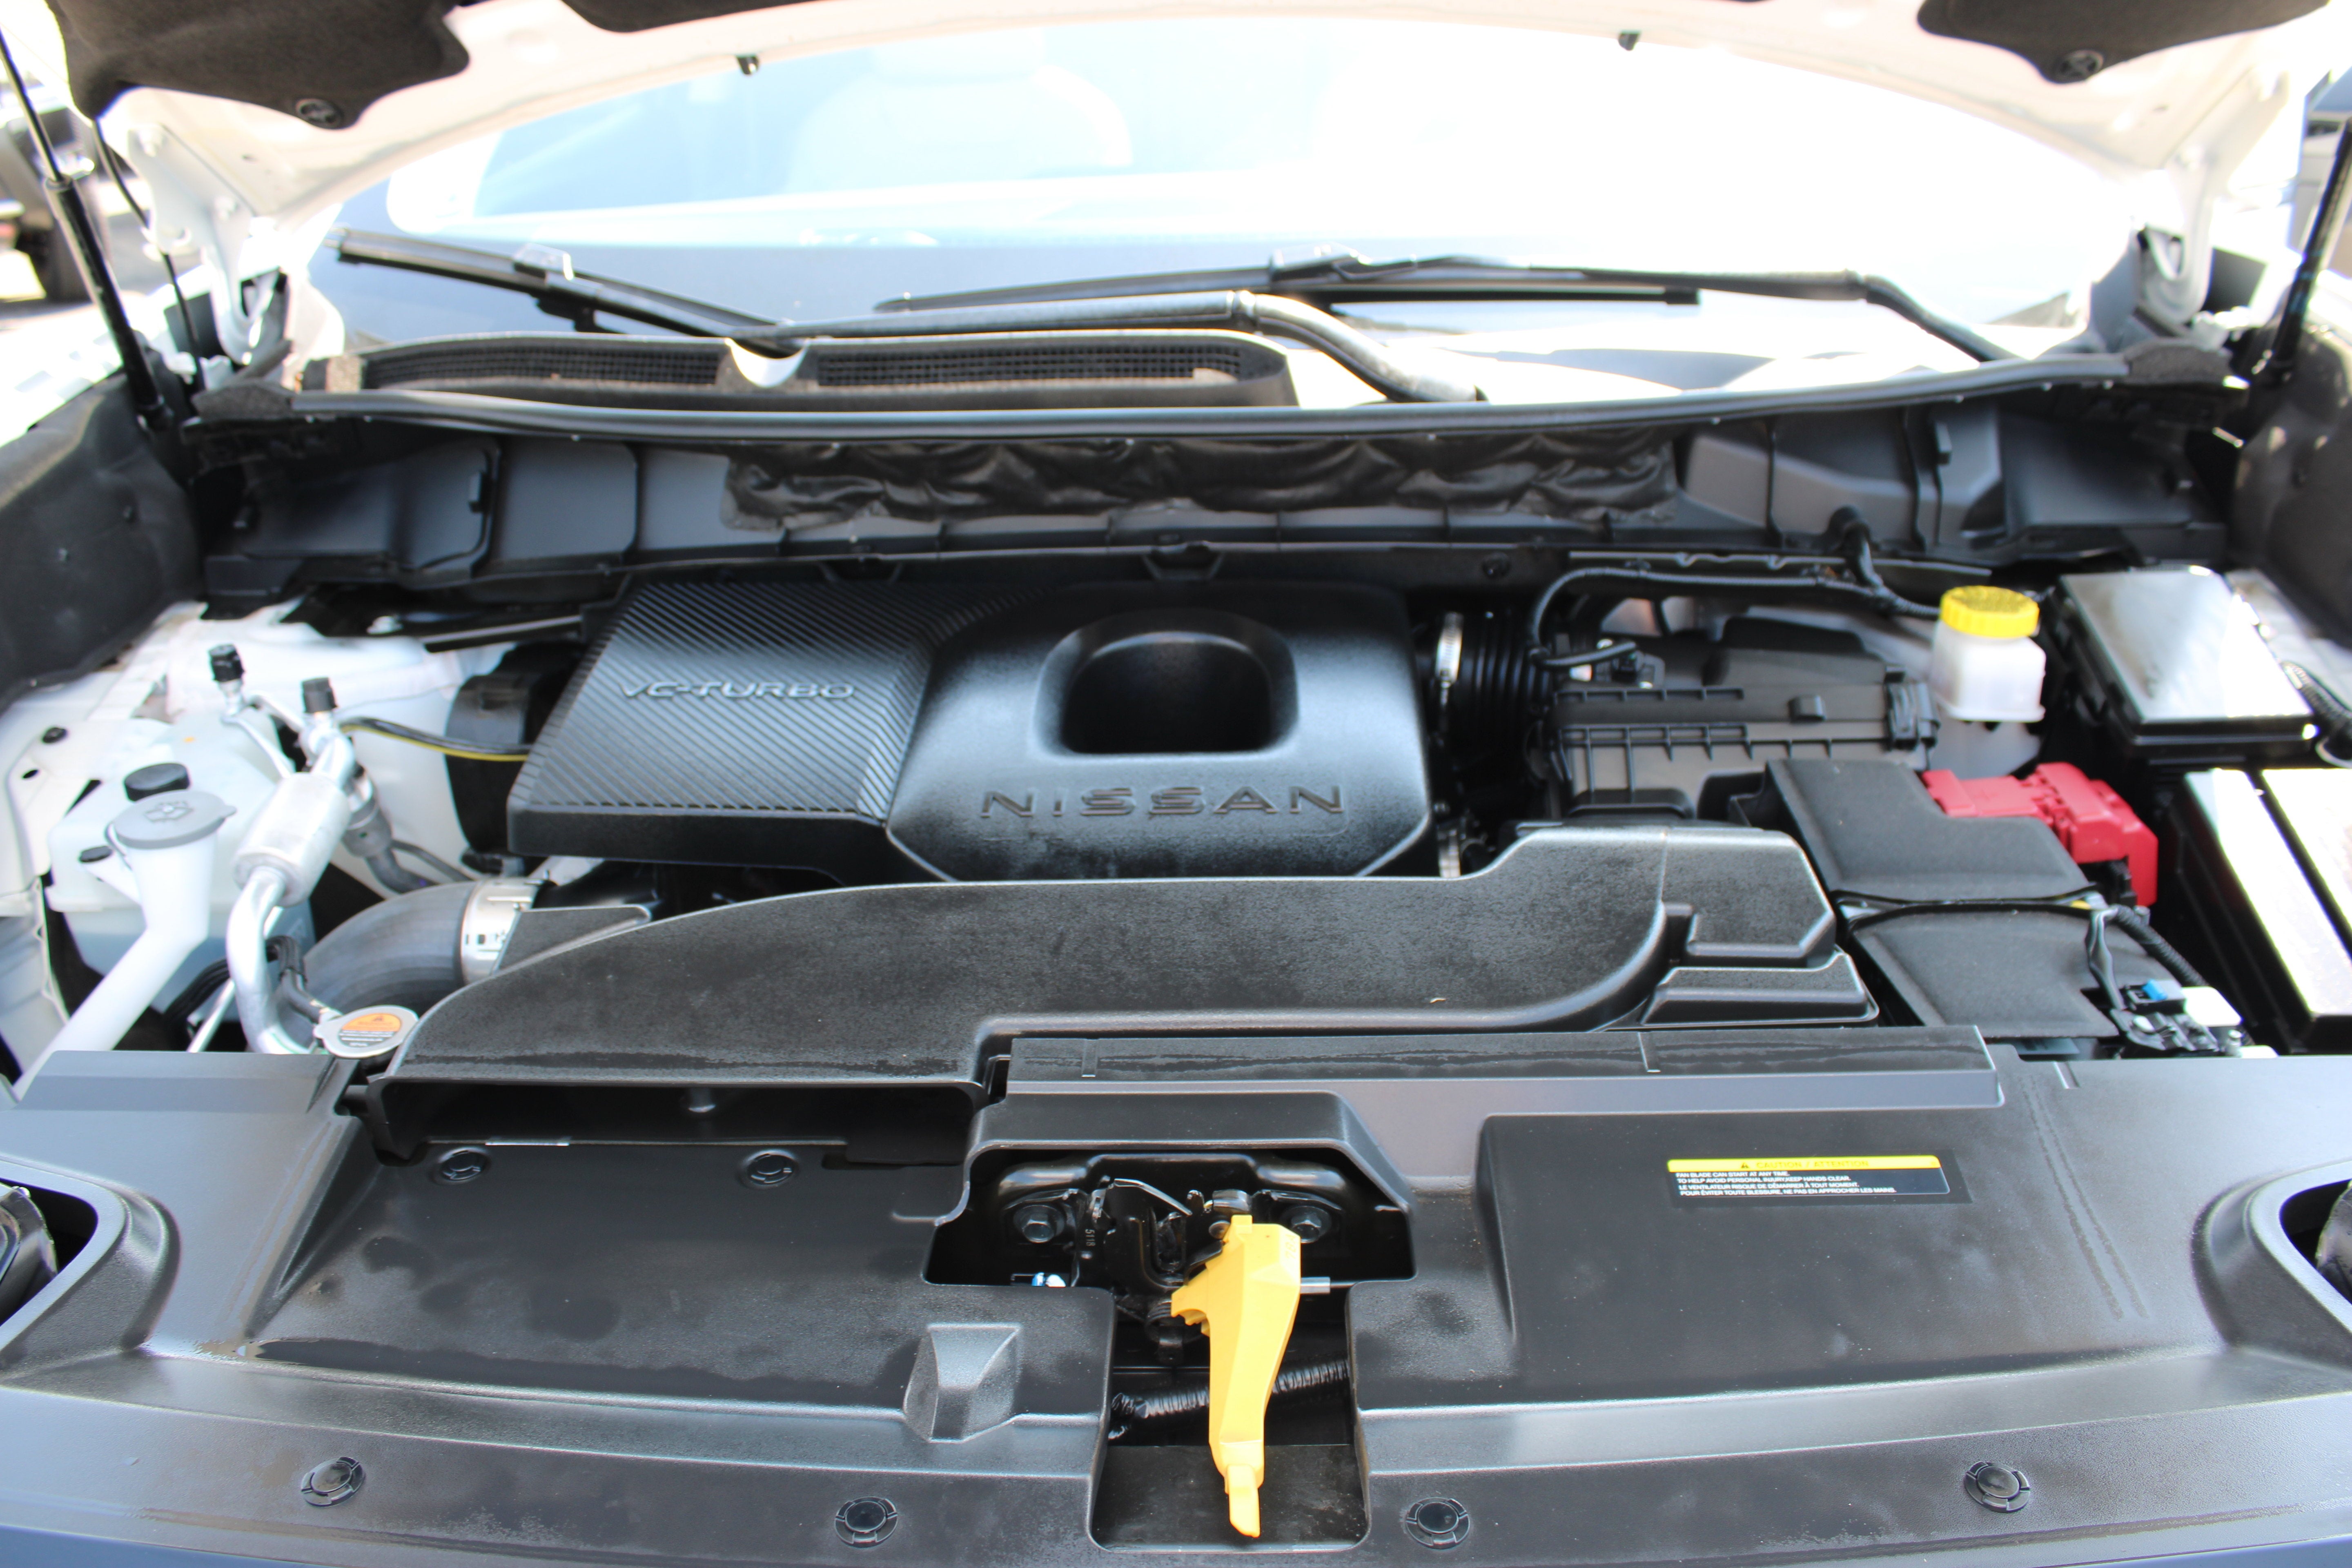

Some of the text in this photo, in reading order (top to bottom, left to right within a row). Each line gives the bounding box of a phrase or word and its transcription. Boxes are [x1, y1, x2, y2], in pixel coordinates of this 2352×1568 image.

[619, 682, 854, 698] VC-TURBO
[981, 786, 1345, 817] NISSAN
[1085, 1229, 1096, 1246] 5118
